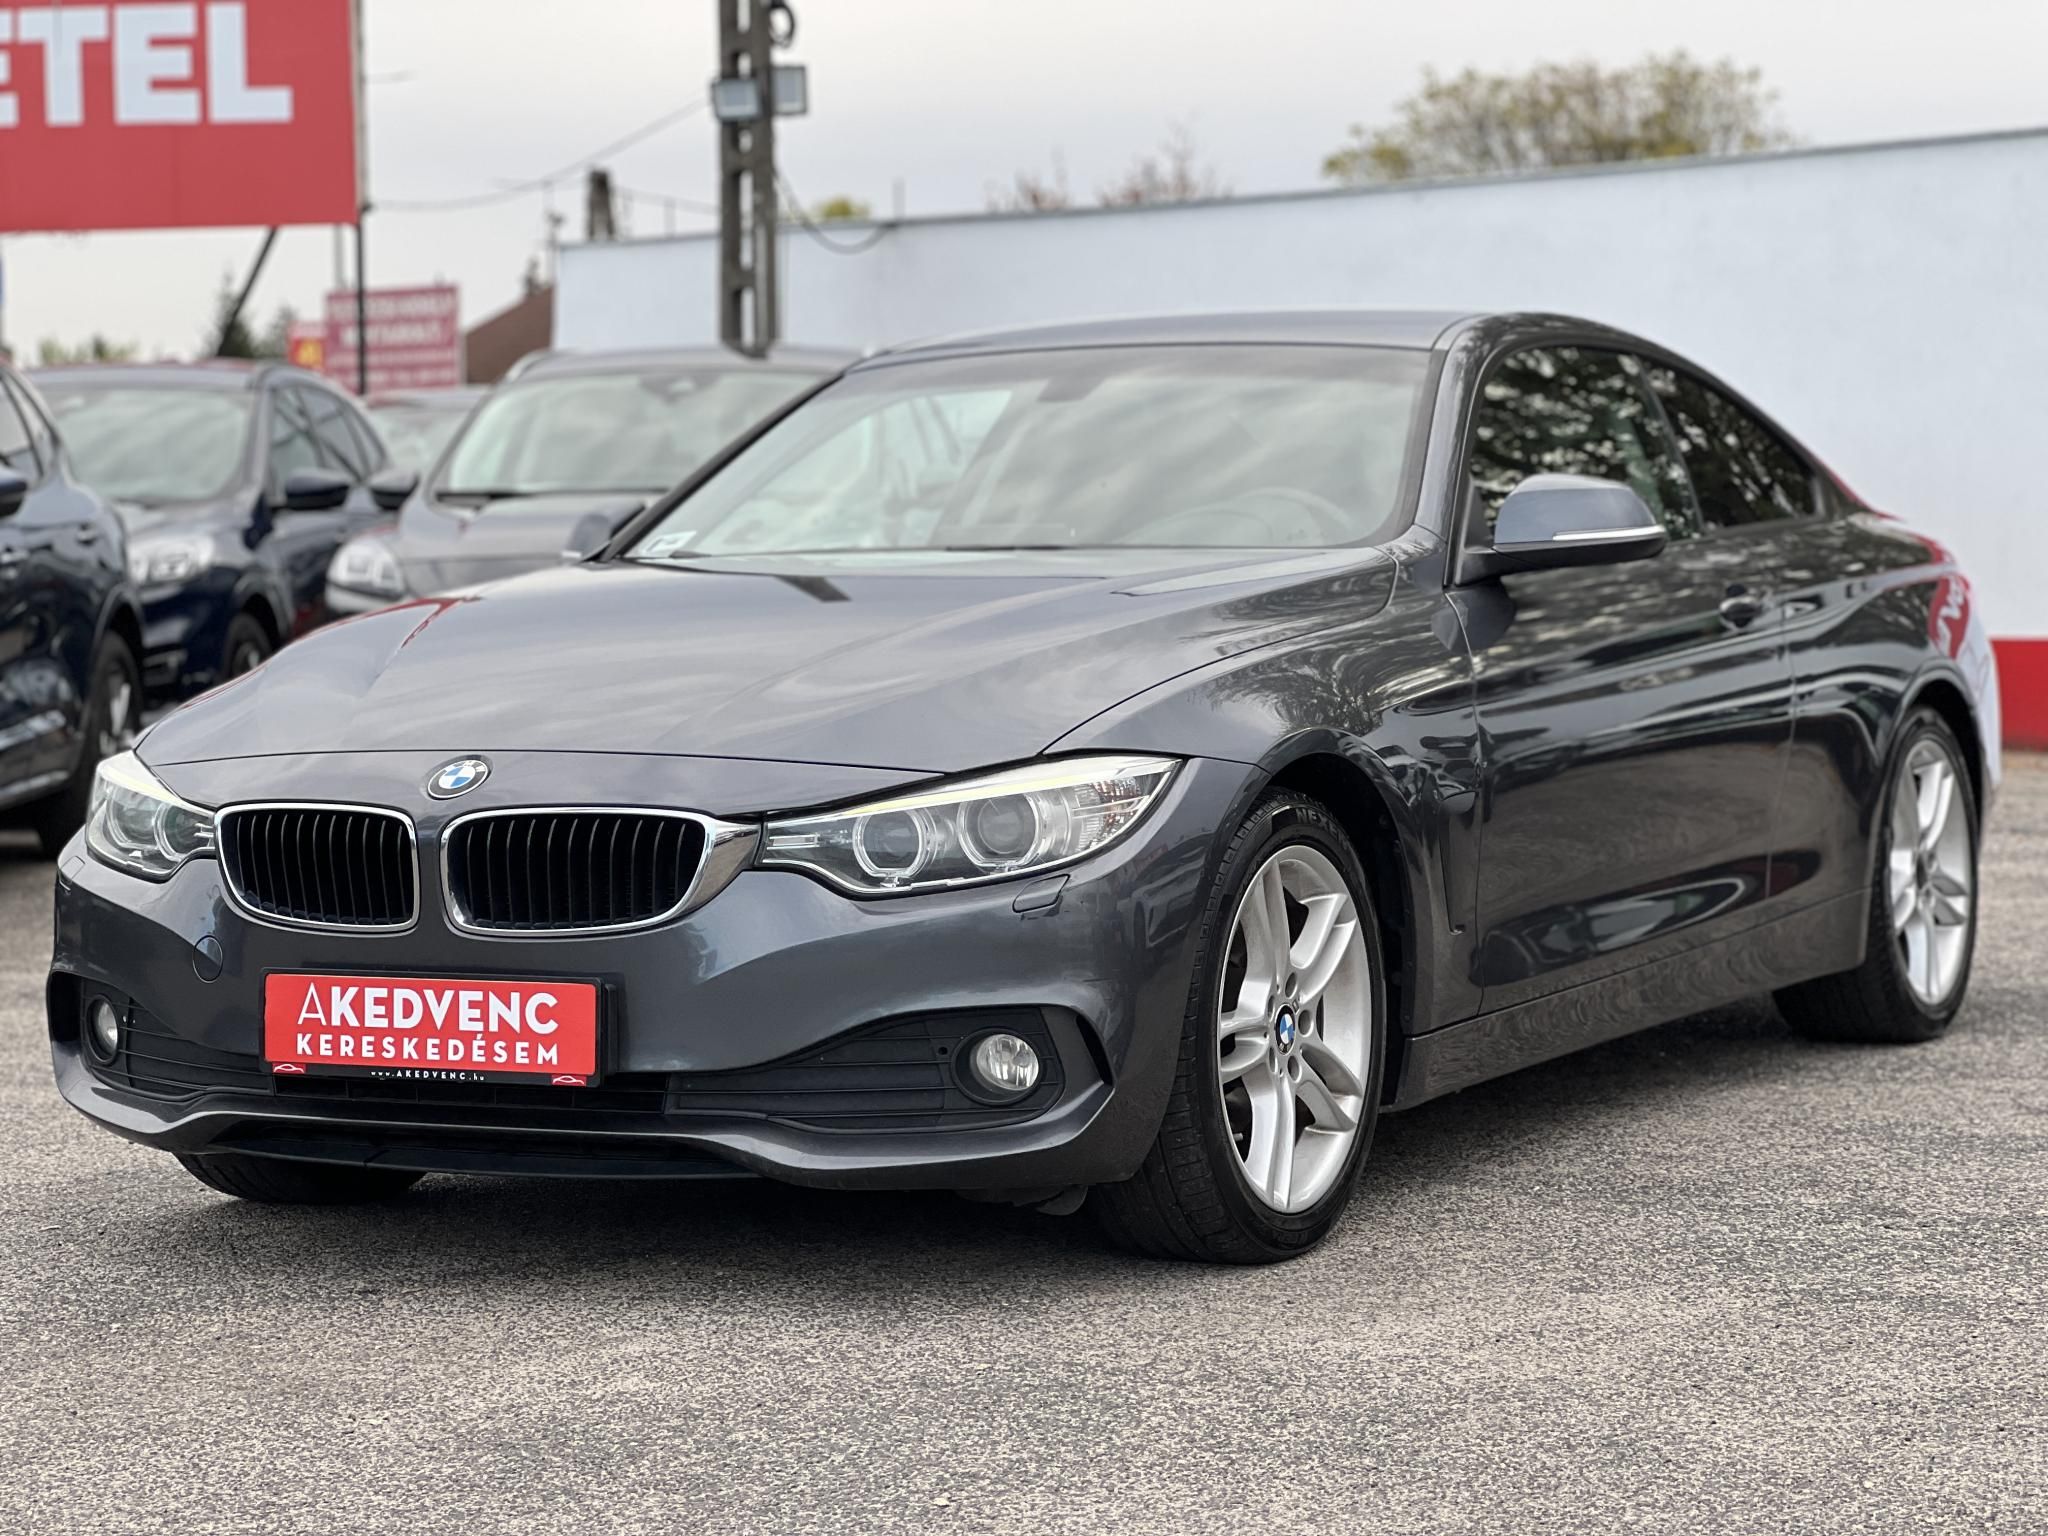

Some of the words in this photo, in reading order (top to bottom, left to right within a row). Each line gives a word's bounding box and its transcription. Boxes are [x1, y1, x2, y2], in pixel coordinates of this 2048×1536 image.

[0, 3, 294, 127] TEL
[298, 982, 559, 1035] AKEDVENC
[296, 1033, 558, 1066] KERESKEDÉSEM
[371, 1069, 485, 1081] www.AKEDVENC.hu
